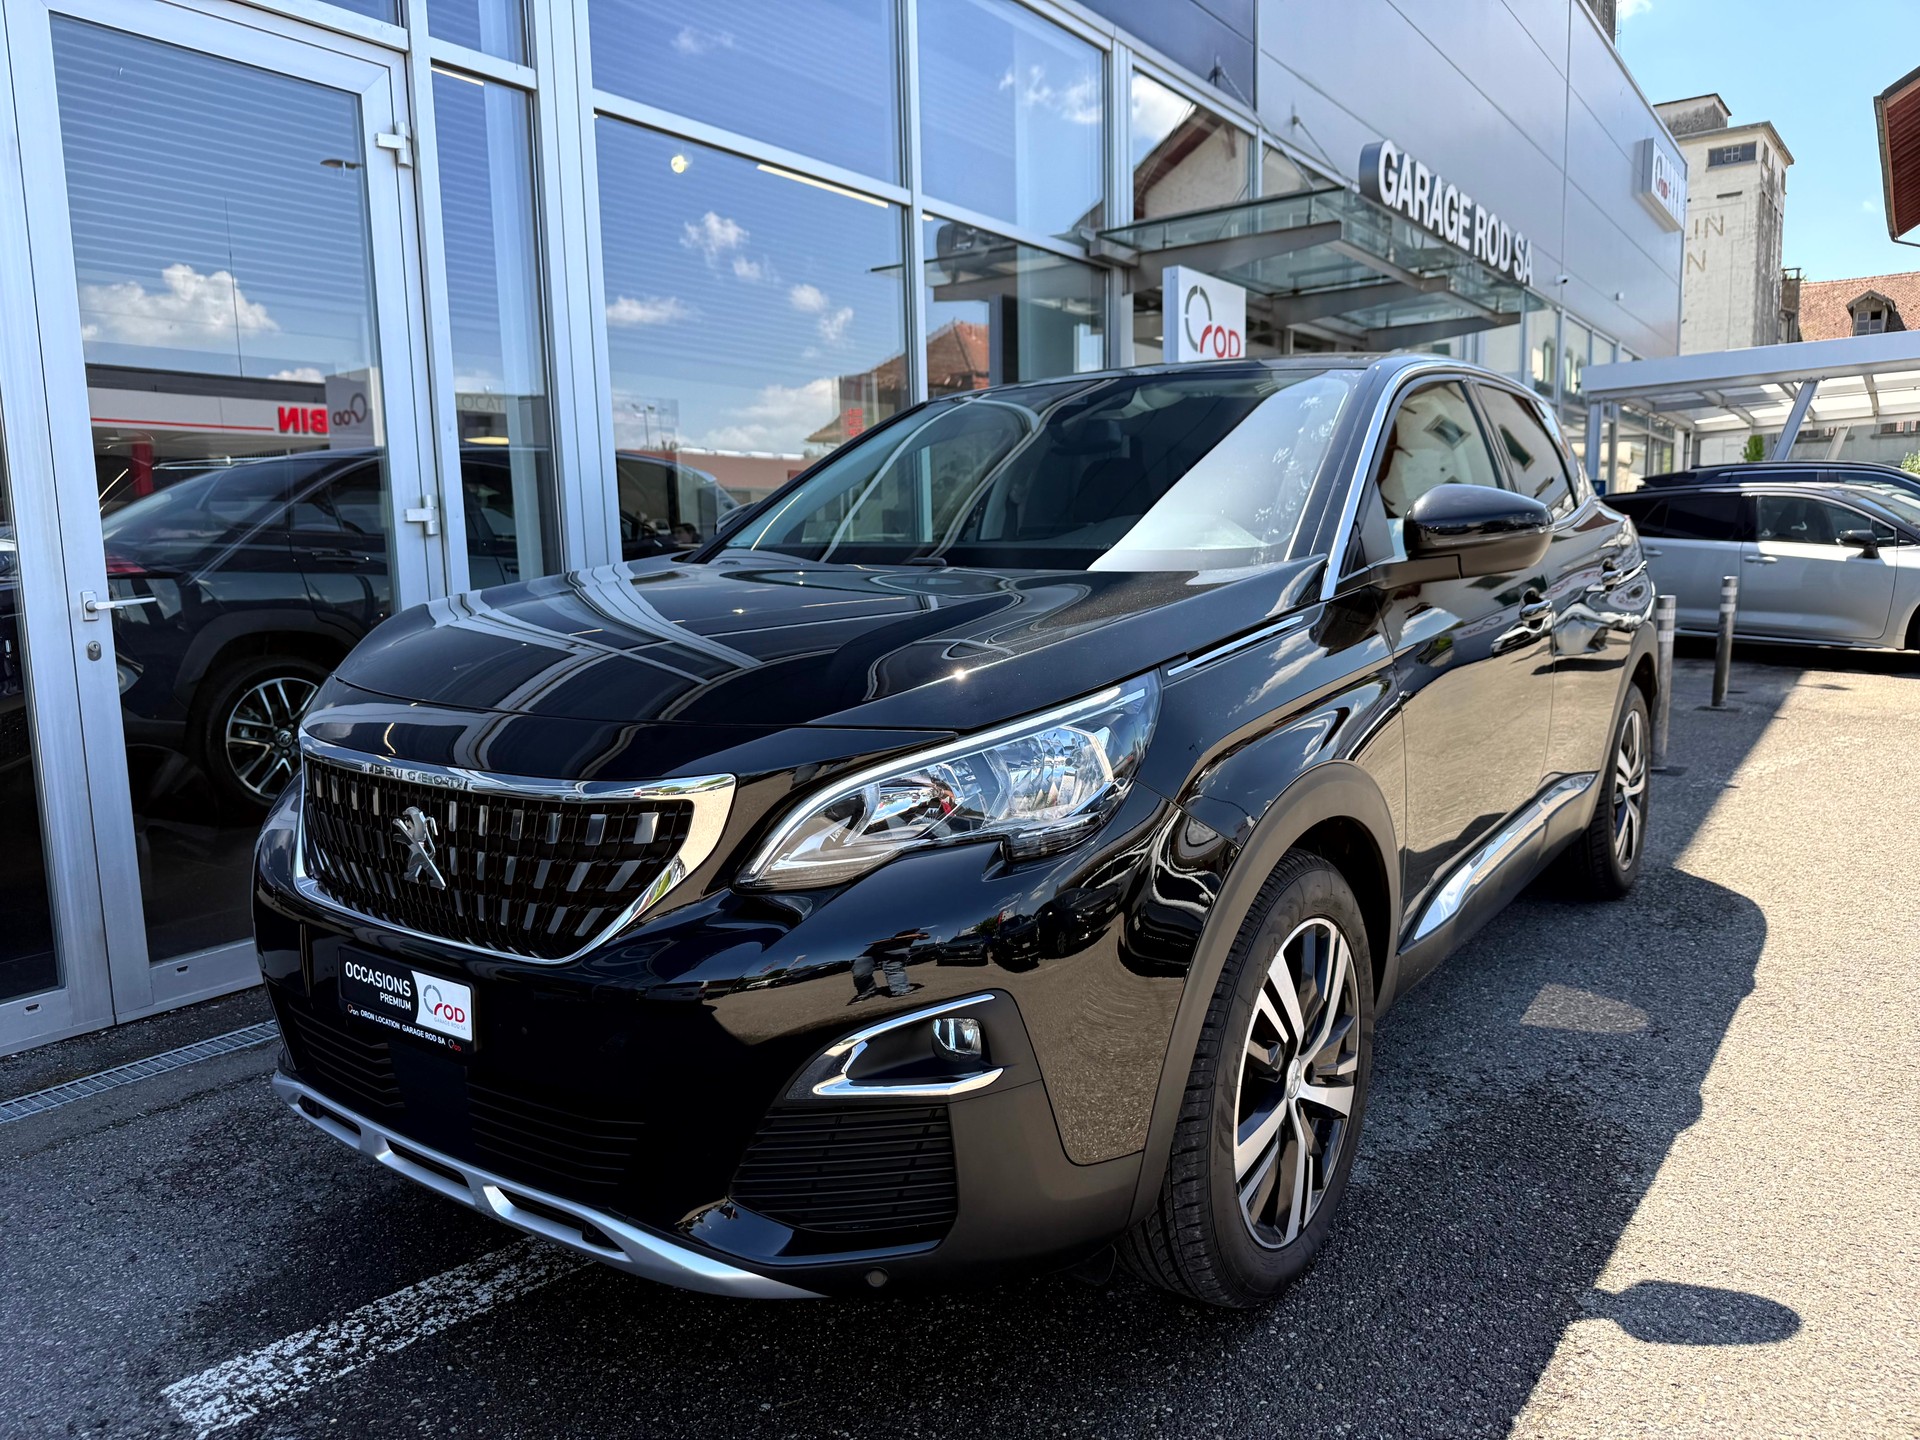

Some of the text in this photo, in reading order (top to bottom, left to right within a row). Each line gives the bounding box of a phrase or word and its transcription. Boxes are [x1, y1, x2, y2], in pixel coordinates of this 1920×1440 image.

[1378, 140, 1533, 287] GARAGE ROD SA
[372, 763, 458, 789] PEUGEOT
[345, 961, 412, 998] OCCASIONS
[380, 992, 412, 1011] PREMIUM
[360, 1009, 375, 1021] ORON
[375, 1015, 401, 1030] LOCATION
[402, 1024, 425, 1038] GARAGE
[424, 1031, 437, 1044] ROD
[437, 1035, 446, 1046] SA
